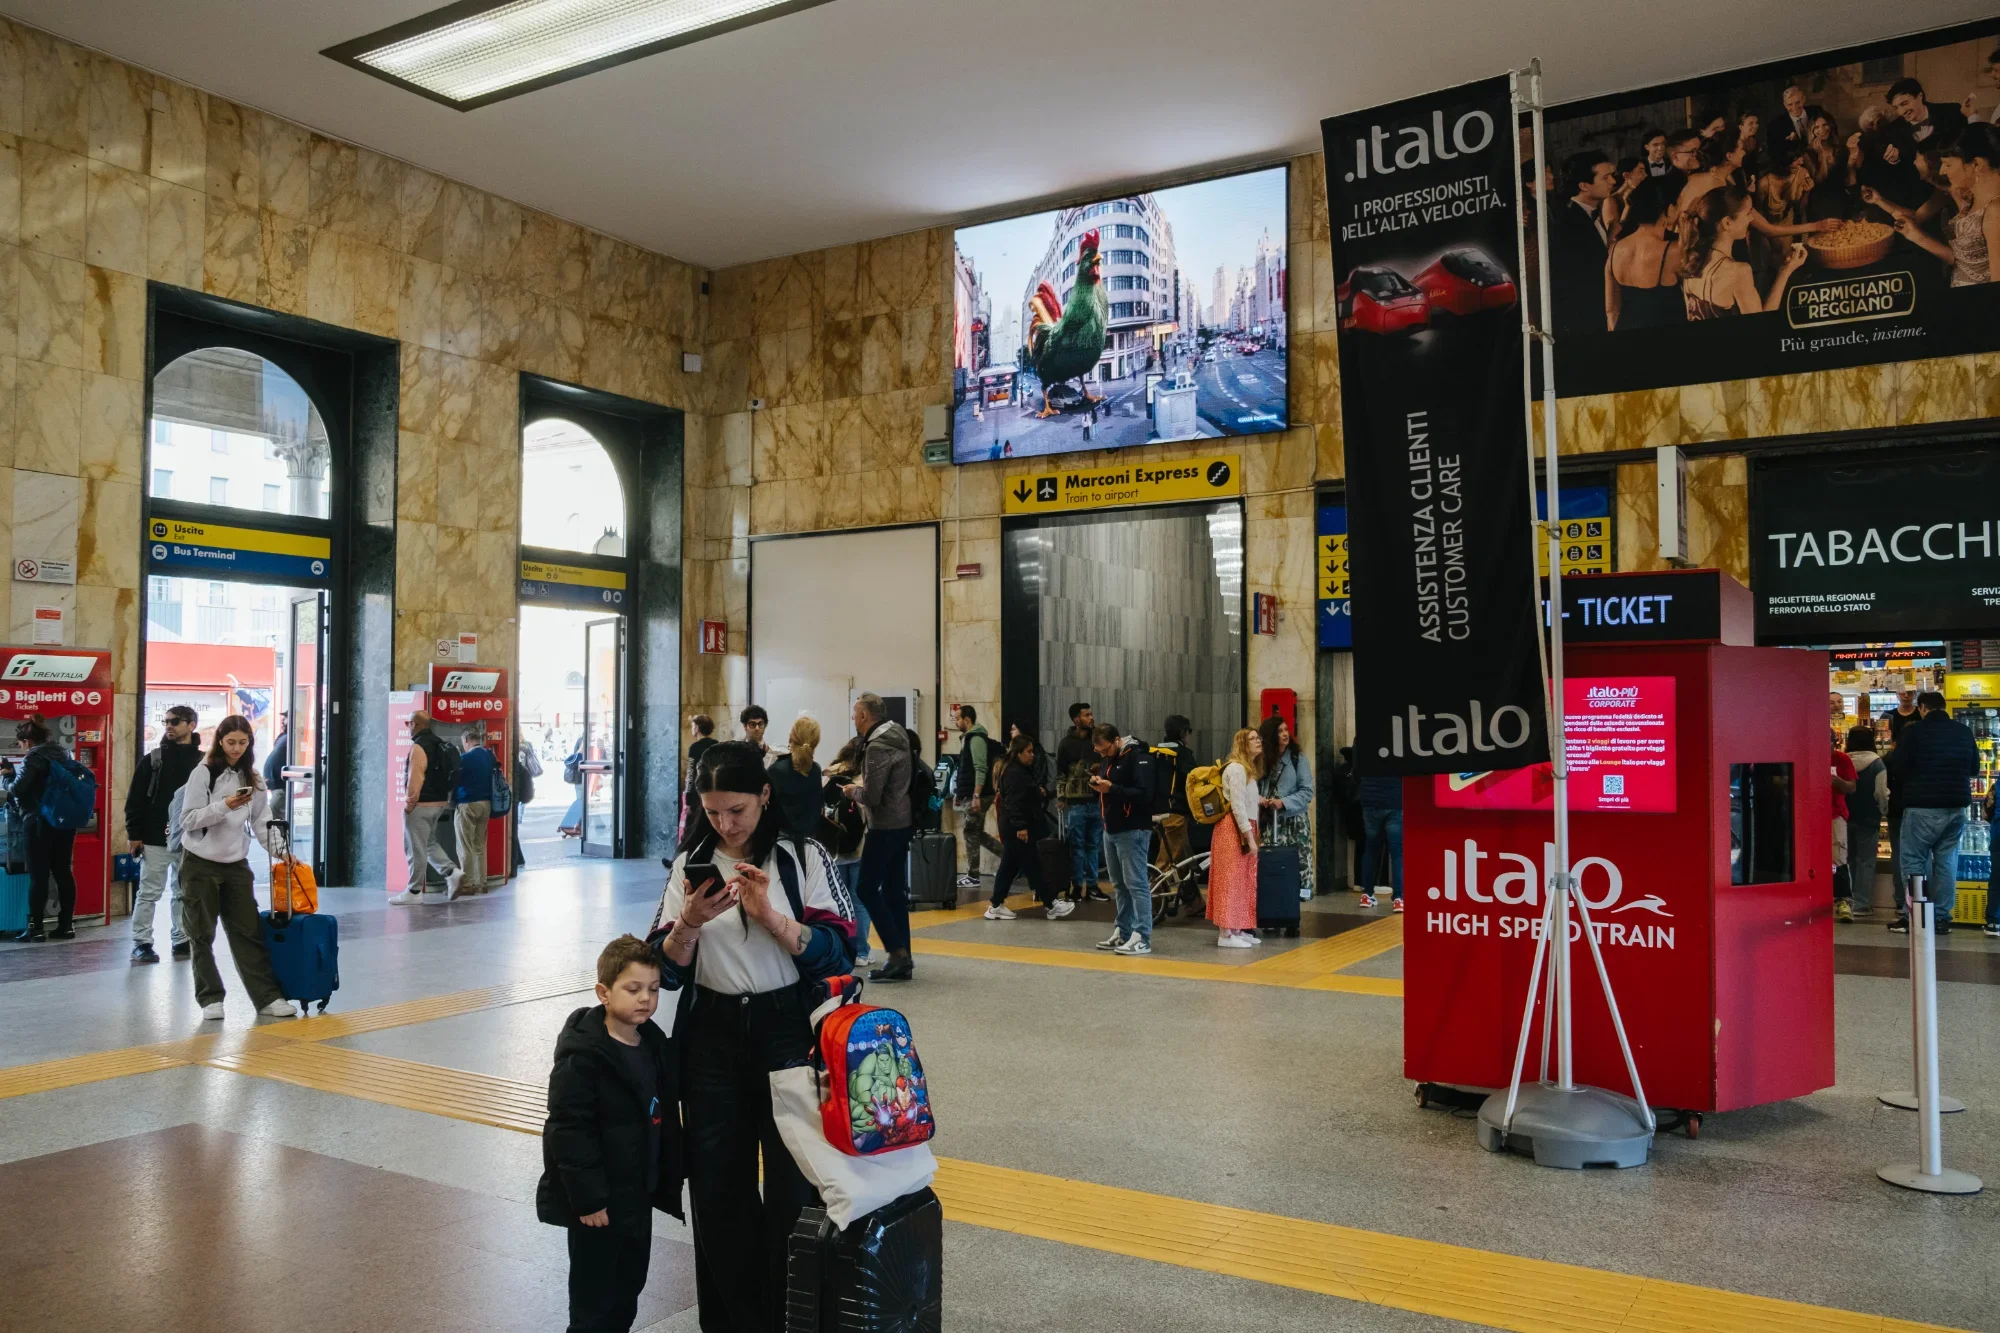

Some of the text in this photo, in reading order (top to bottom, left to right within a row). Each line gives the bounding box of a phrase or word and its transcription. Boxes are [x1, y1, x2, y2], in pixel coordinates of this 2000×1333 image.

[1354, 175, 1489, 219] I PROFESSIONISTI
[1422, 188, 1507, 223] VELOCITÀ.
[1798, 277, 1903, 305] PARMIGIANO
[1808, 295, 1893, 319] REGGIANO
[1780, 325, 1926, 352] Più grande, insieme.
[1065, 466, 1199, 489] Marconi Express
[1065, 488, 1139, 504] Train to airport
[174, 524, 204, 536] Uscita
[1406, 410, 1442, 643] ASSISTENZA CLIENTI
[174, 545, 236, 560] Bus Terminal
[1437, 454, 1470, 640] CUSTOMER CARE
[523, 563, 543, 573] Uscita
[1769, 592, 1876, 604] BIGLIETTERIA REGIONALE
[1577, 595, 1673, 626] TICKET
[1769, 603, 1871, 615] FERROVIA DELLO STATO
[32, 671, 83, 679] TRENITALIA
[15, 690, 67, 704] Biglietti
[449, 700, 481, 710] Biglietti
[1589, 700, 1636, 708] CORPORATE
[15, 702, 39, 711] Tickets
[1427, 912, 1675, 950] HIGH SPED TRAIN
